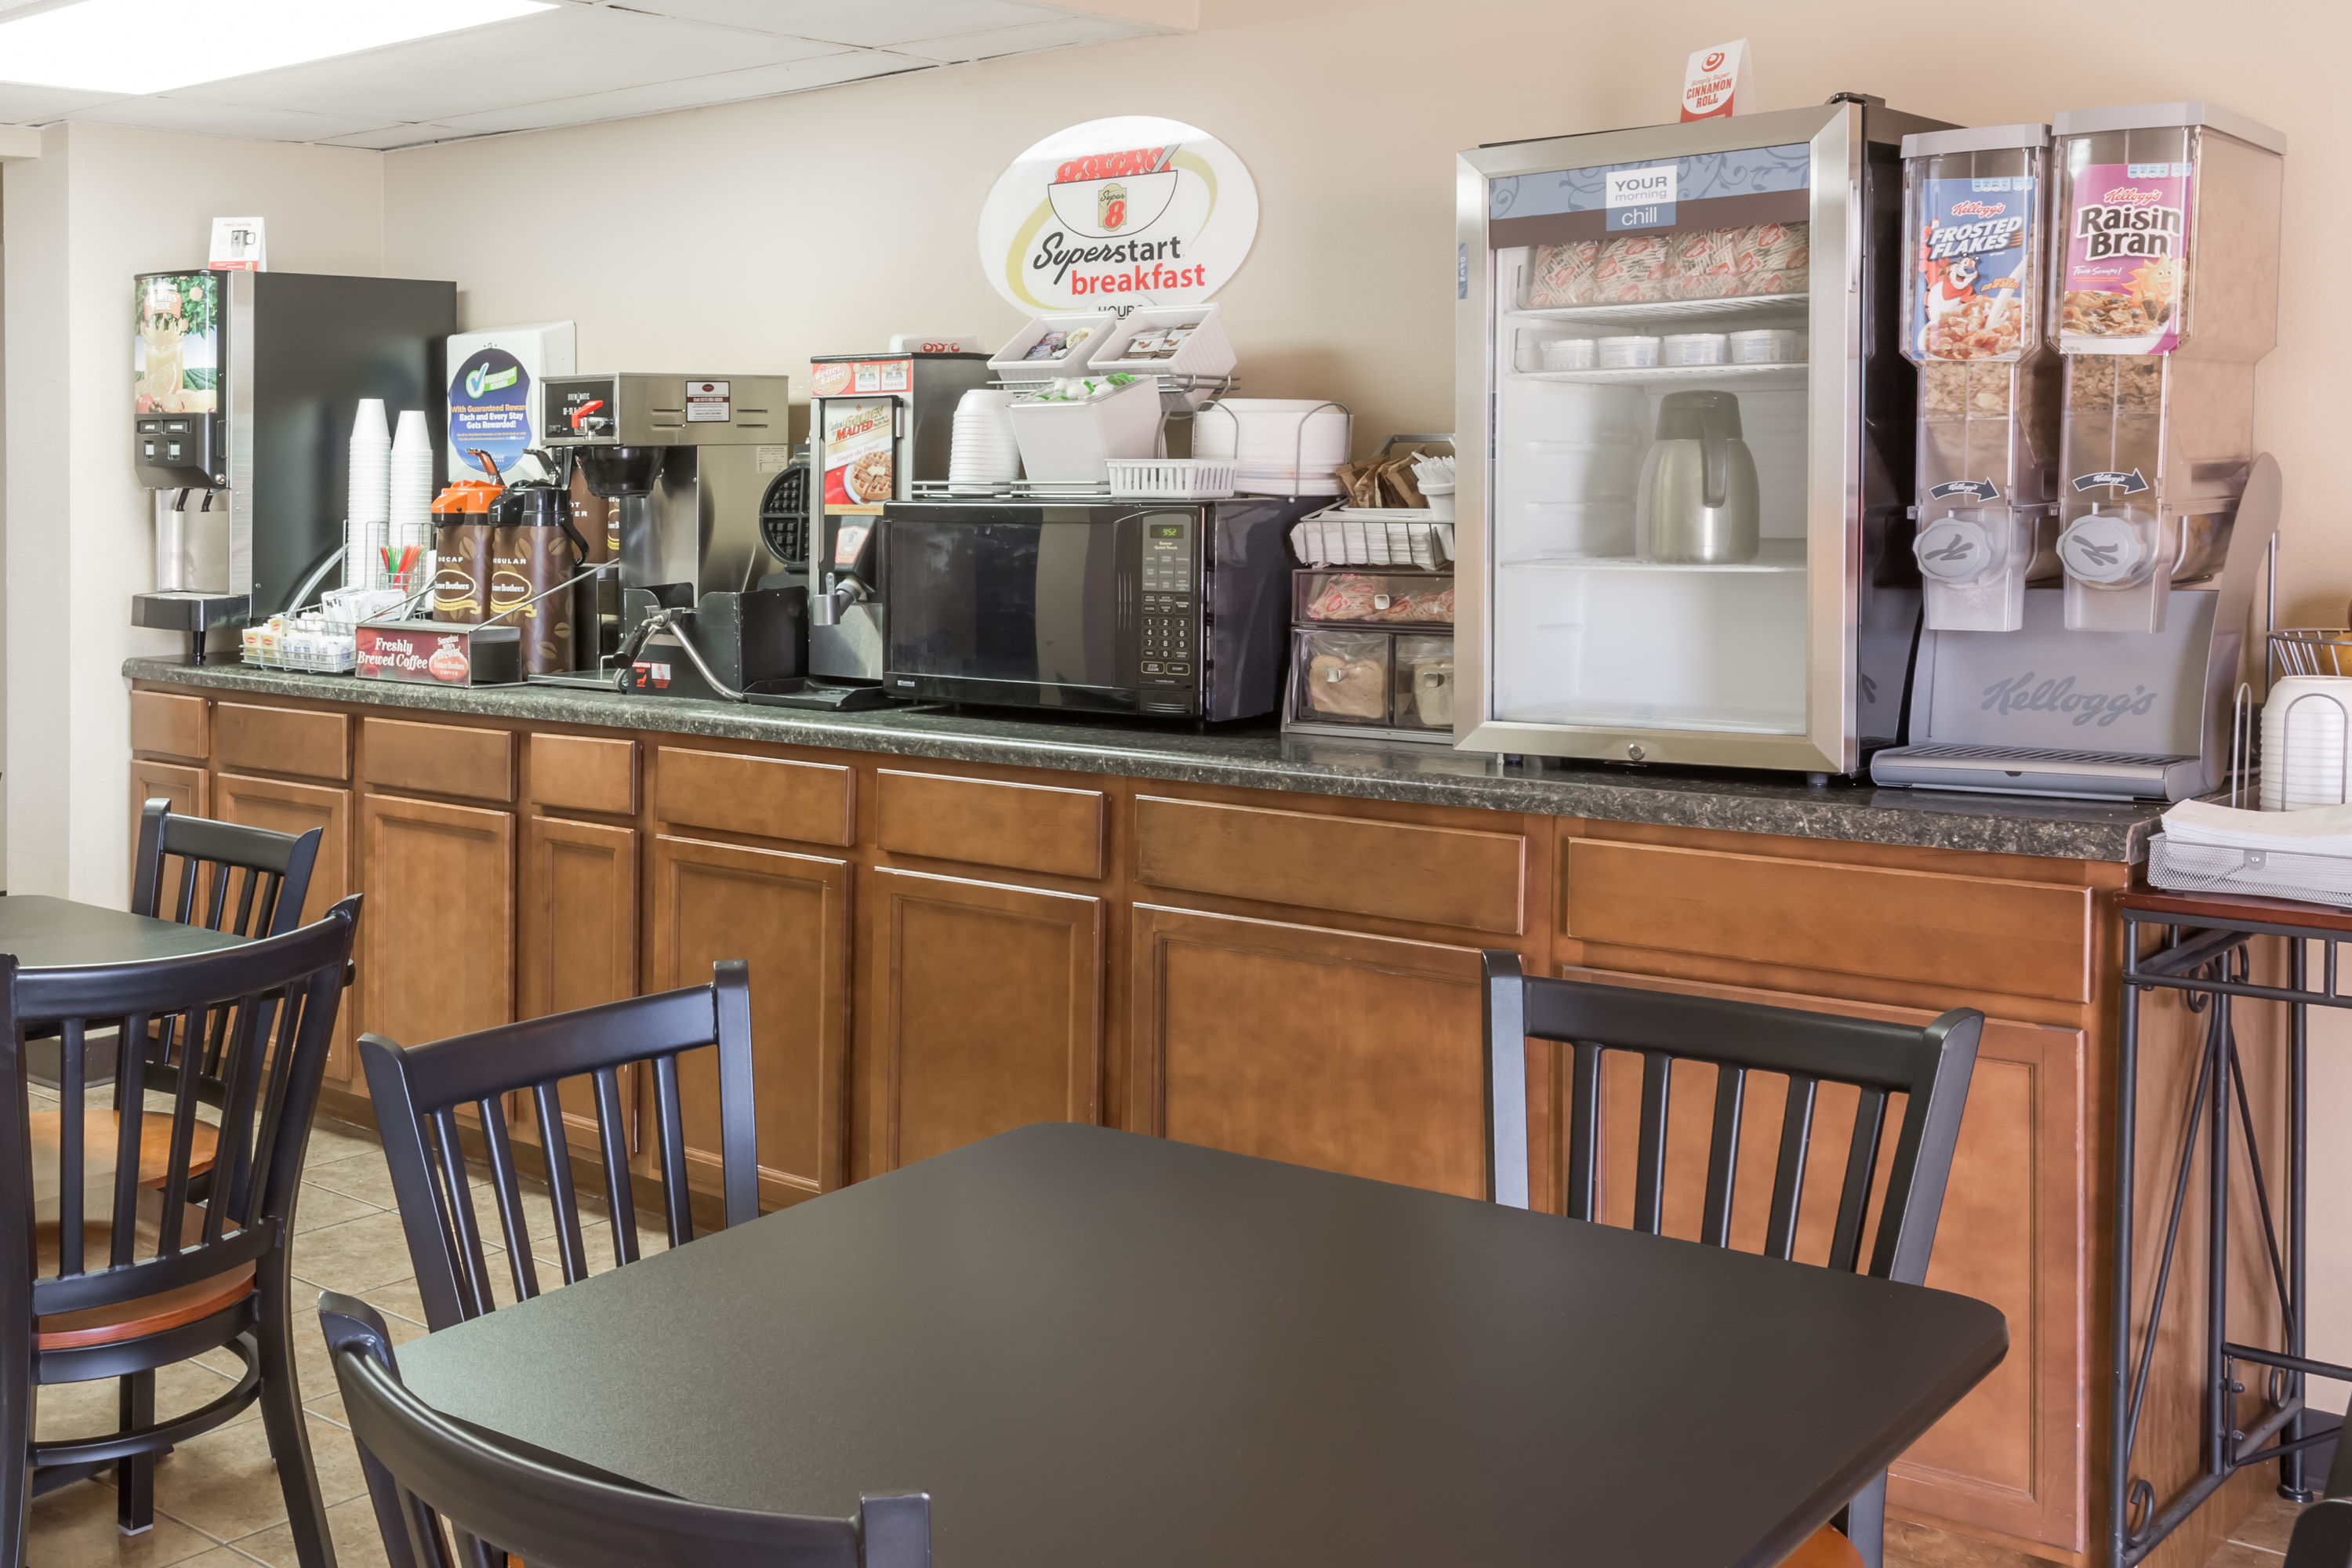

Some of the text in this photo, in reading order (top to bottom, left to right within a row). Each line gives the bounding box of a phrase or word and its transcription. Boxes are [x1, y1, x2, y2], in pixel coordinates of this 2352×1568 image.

[1686, 78, 1733, 100] CINNAMON
[1696, 93, 1719, 108] ROLL
[1615, 176, 1667, 191] YOUR
[1100, 190, 1126, 206] Super
[1615, 190, 1667, 201] morning
[2104, 188, 2161, 205] Kellogg's
[1104, 201, 1124, 228] 8
[1621, 206, 1657, 226] chill
[1952, 201, 2005, 218] Kellogg's
[2078, 205, 2181, 237] Raisin
[1929, 217, 2023, 245] FROSTED
[1929, 234, 2011, 260] FLAKES
[2089, 231, 2169, 259] Bran
[1033, 231, 1181, 285] Superstart
[1072, 263, 1206, 296] breakfast
[467, 404, 503, 413] Guaranteed
[489, 412, 508, 422] Every
[509, 412, 524, 421] Stay
[844, 405, 884, 427] GOLDEN
[482, 420, 516, 429] Rewarded!
[836, 419, 873, 441] MALTED
[1947, 482, 1978, 492] Kellogg's
[2092, 474, 2127, 484] Kellogg's
[375, 637, 413, 655] Freshly
[357, 651, 428, 670] Brewed Coffee
[1981, 671, 2158, 728] Kellogg's
